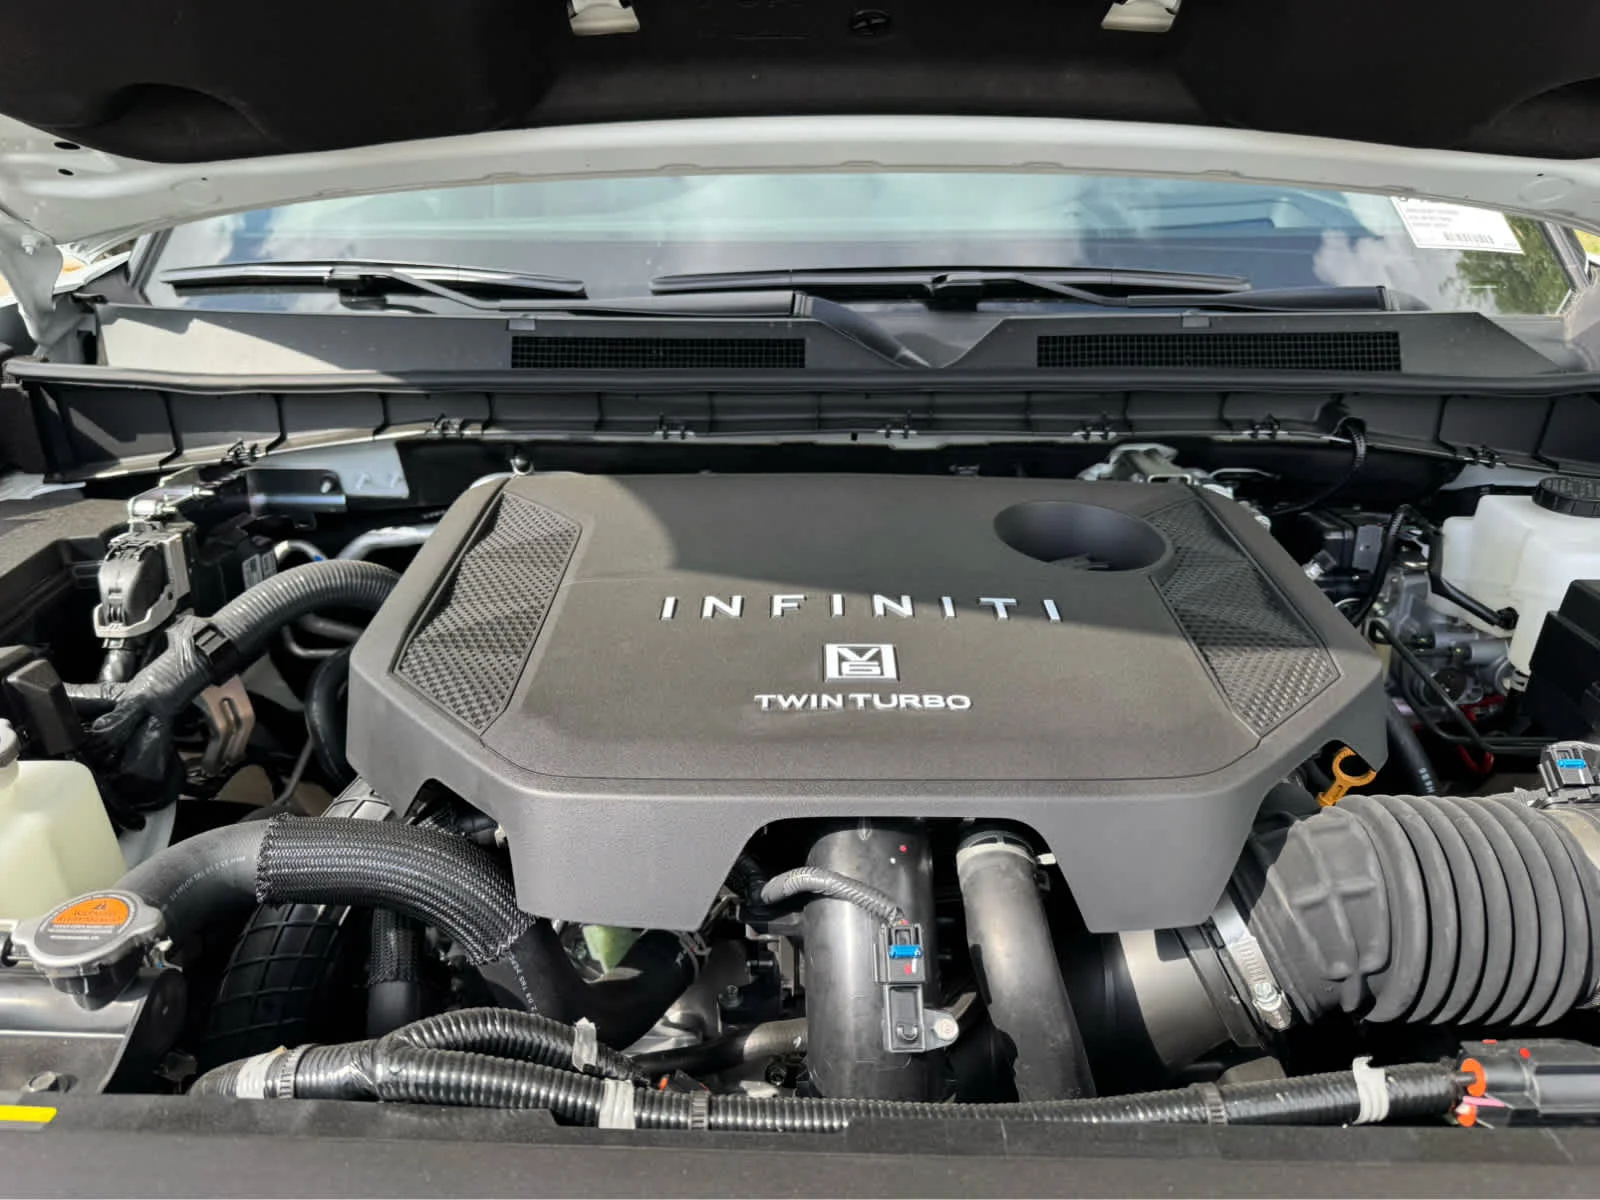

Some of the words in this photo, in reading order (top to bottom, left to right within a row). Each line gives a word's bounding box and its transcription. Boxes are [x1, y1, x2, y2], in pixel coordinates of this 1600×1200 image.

[660, 593, 1062, 622] INFINITI
[755, 693, 843, 711] TWIN
[849, 693, 972, 711] TURBO
